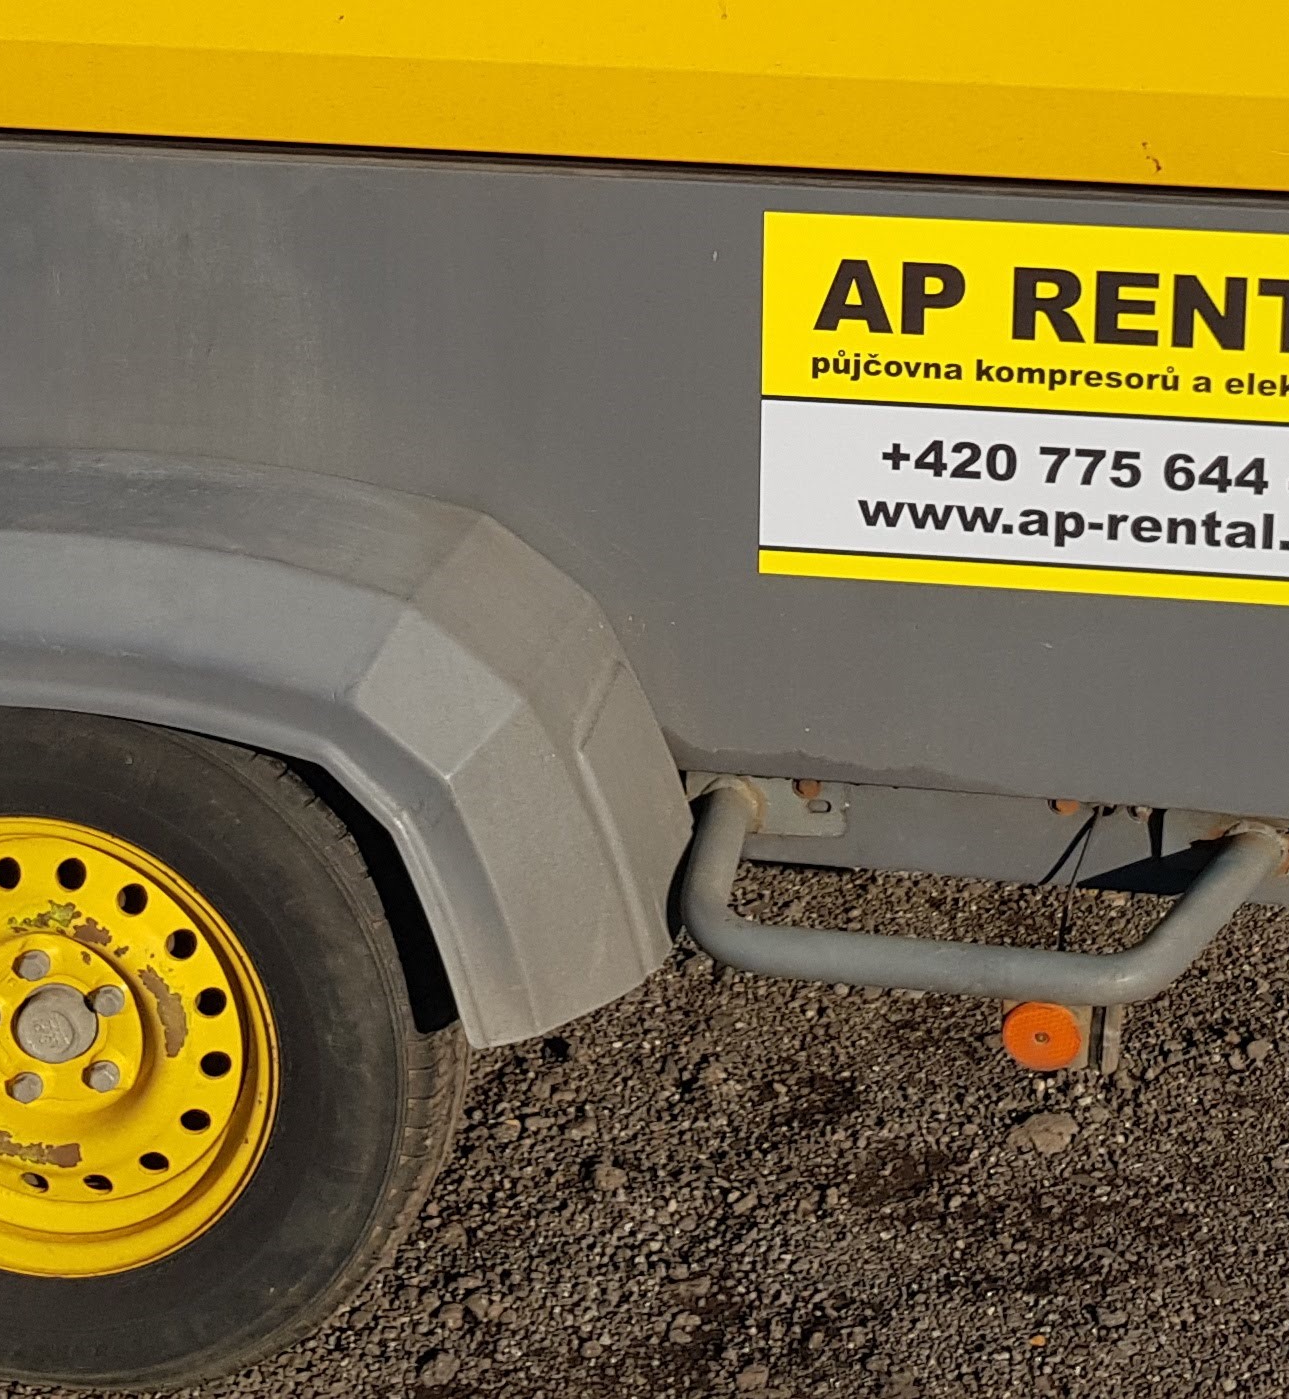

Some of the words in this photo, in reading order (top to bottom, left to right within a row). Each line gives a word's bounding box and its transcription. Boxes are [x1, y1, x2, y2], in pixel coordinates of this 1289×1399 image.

[812, 258, 966, 336] AP
[811, 349, 963, 382] půjčovna
[975, 358, 1180, 391] kompresorů
[1191, 375, 1212, 394] a
[881, 439, 1018, 482] +420
[1038, 446, 1142, 489] 775
[1163, 453, 1270, 496] 644
